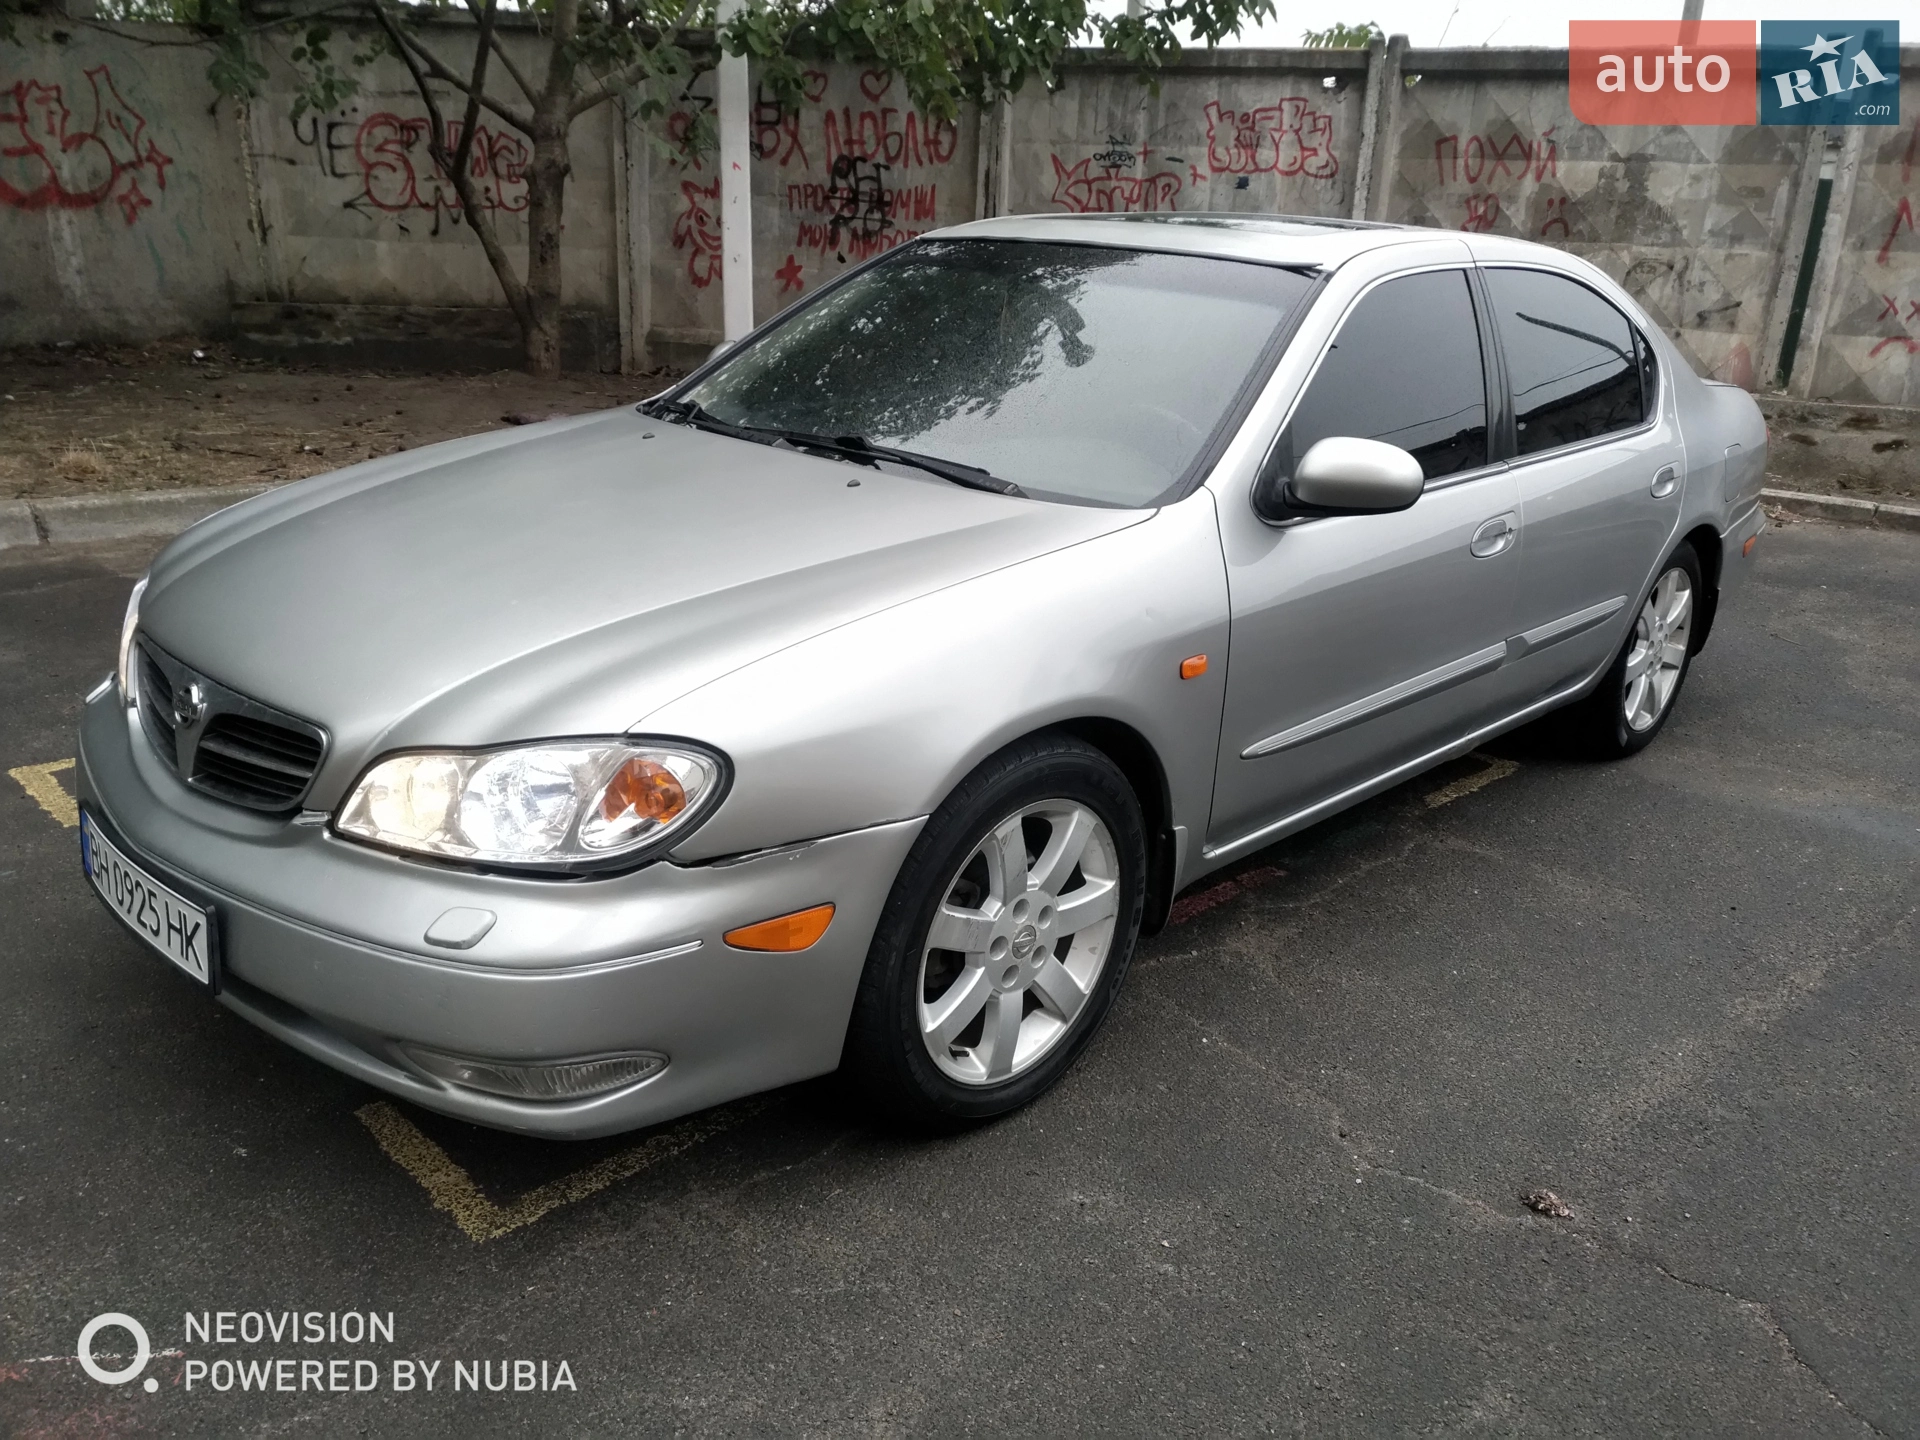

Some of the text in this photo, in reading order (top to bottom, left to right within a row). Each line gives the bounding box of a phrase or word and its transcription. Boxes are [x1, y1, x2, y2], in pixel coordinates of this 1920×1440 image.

[824, 106, 958, 175] ЛЮБЛЮ
[89, 829, 204, 973] BH 0925 HK
